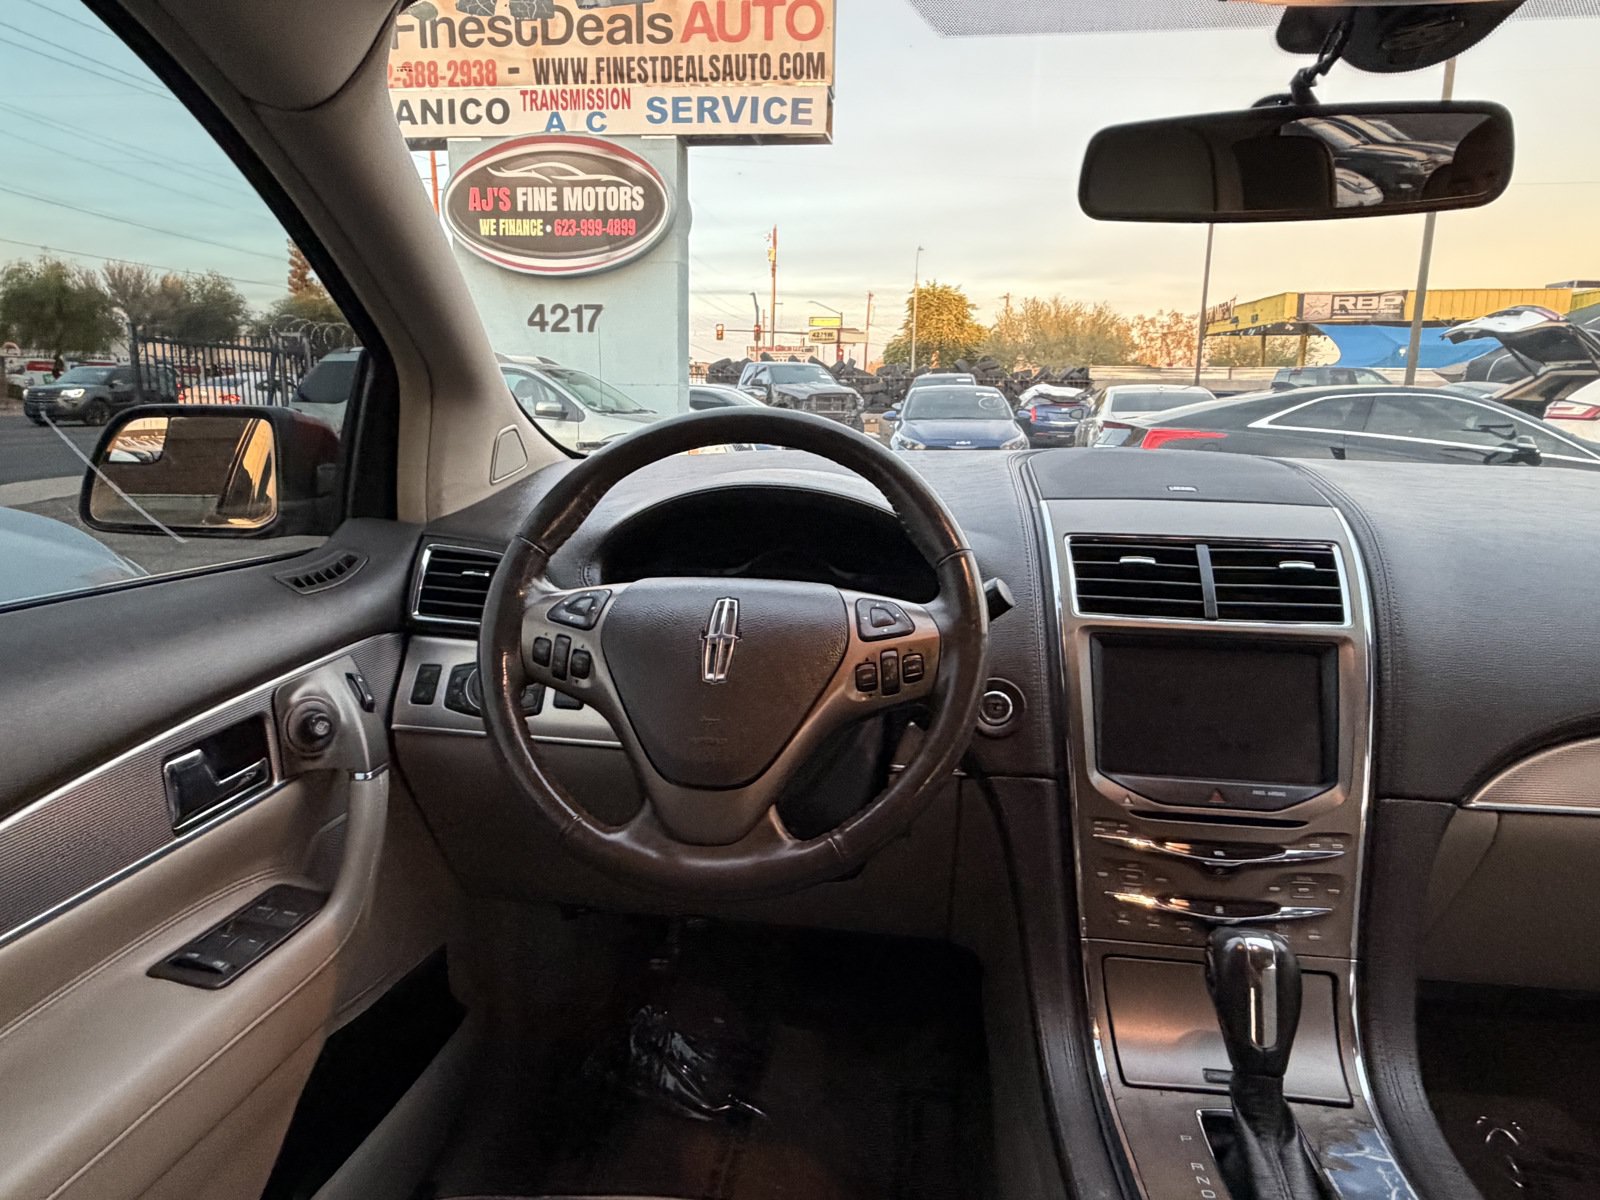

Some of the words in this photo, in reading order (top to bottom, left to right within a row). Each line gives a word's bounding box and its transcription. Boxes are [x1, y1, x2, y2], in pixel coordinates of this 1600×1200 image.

[680, 0, 825, 43] AUTO
[532, 51, 826, 86] WWW.FINESTDEALSAUTO.COM
[519, 87, 632, 112] TRANSMISSION
[645, 95, 814, 126] SERVICE
[468, 187, 512, 212] AJ'S
[516, 186, 558, 212] FINE
[562, 186, 645, 212] MOTORS
[479, 218, 497, 236] WE
[499, 218, 544, 236] FINANCE
[553, 218, 636, 236] 623-999-4899
[527, 303, 603, 333] 4217
